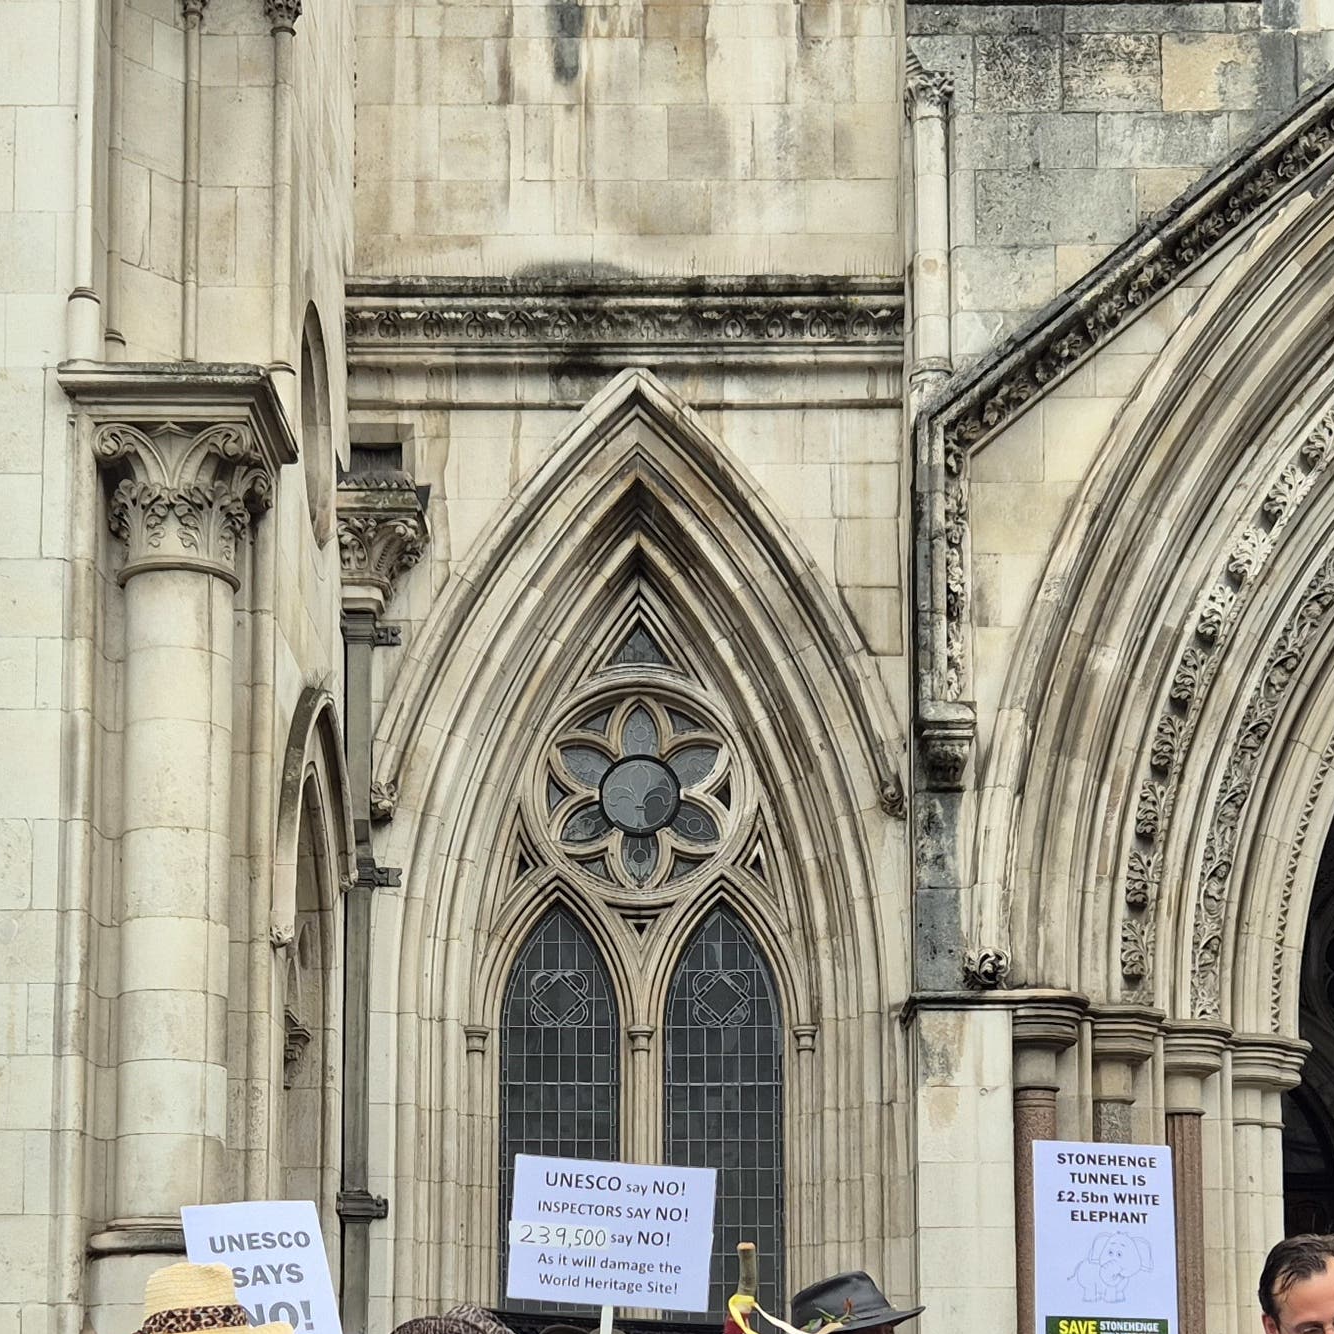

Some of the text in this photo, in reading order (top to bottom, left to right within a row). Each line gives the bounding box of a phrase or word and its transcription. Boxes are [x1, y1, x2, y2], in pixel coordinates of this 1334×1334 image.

[1057, 1153, 1157, 1169] STONEHENGE
[545, 1171, 686, 1197] UNESCO say NO!
[1070, 1173, 1146, 1187] TUNNEL IS
[1057, 1191, 1160, 1206] £2.5bn WHITE
[537, 1200, 688, 1222] INSPECTORS SAY NO!
[1071, 1210, 1148, 1224] ELEPHANT
[209, 1231, 310, 1254] UNESCO
[519, 1224, 671, 1248] 239,500 say NO!
[537, 1253, 682, 1275] As it will damage the
[232, 1263, 304, 1288] SAYS
[539, 1273, 678, 1295] World Heritage Site!
[1099, 1320, 1159, 1333] STONEHENGE
